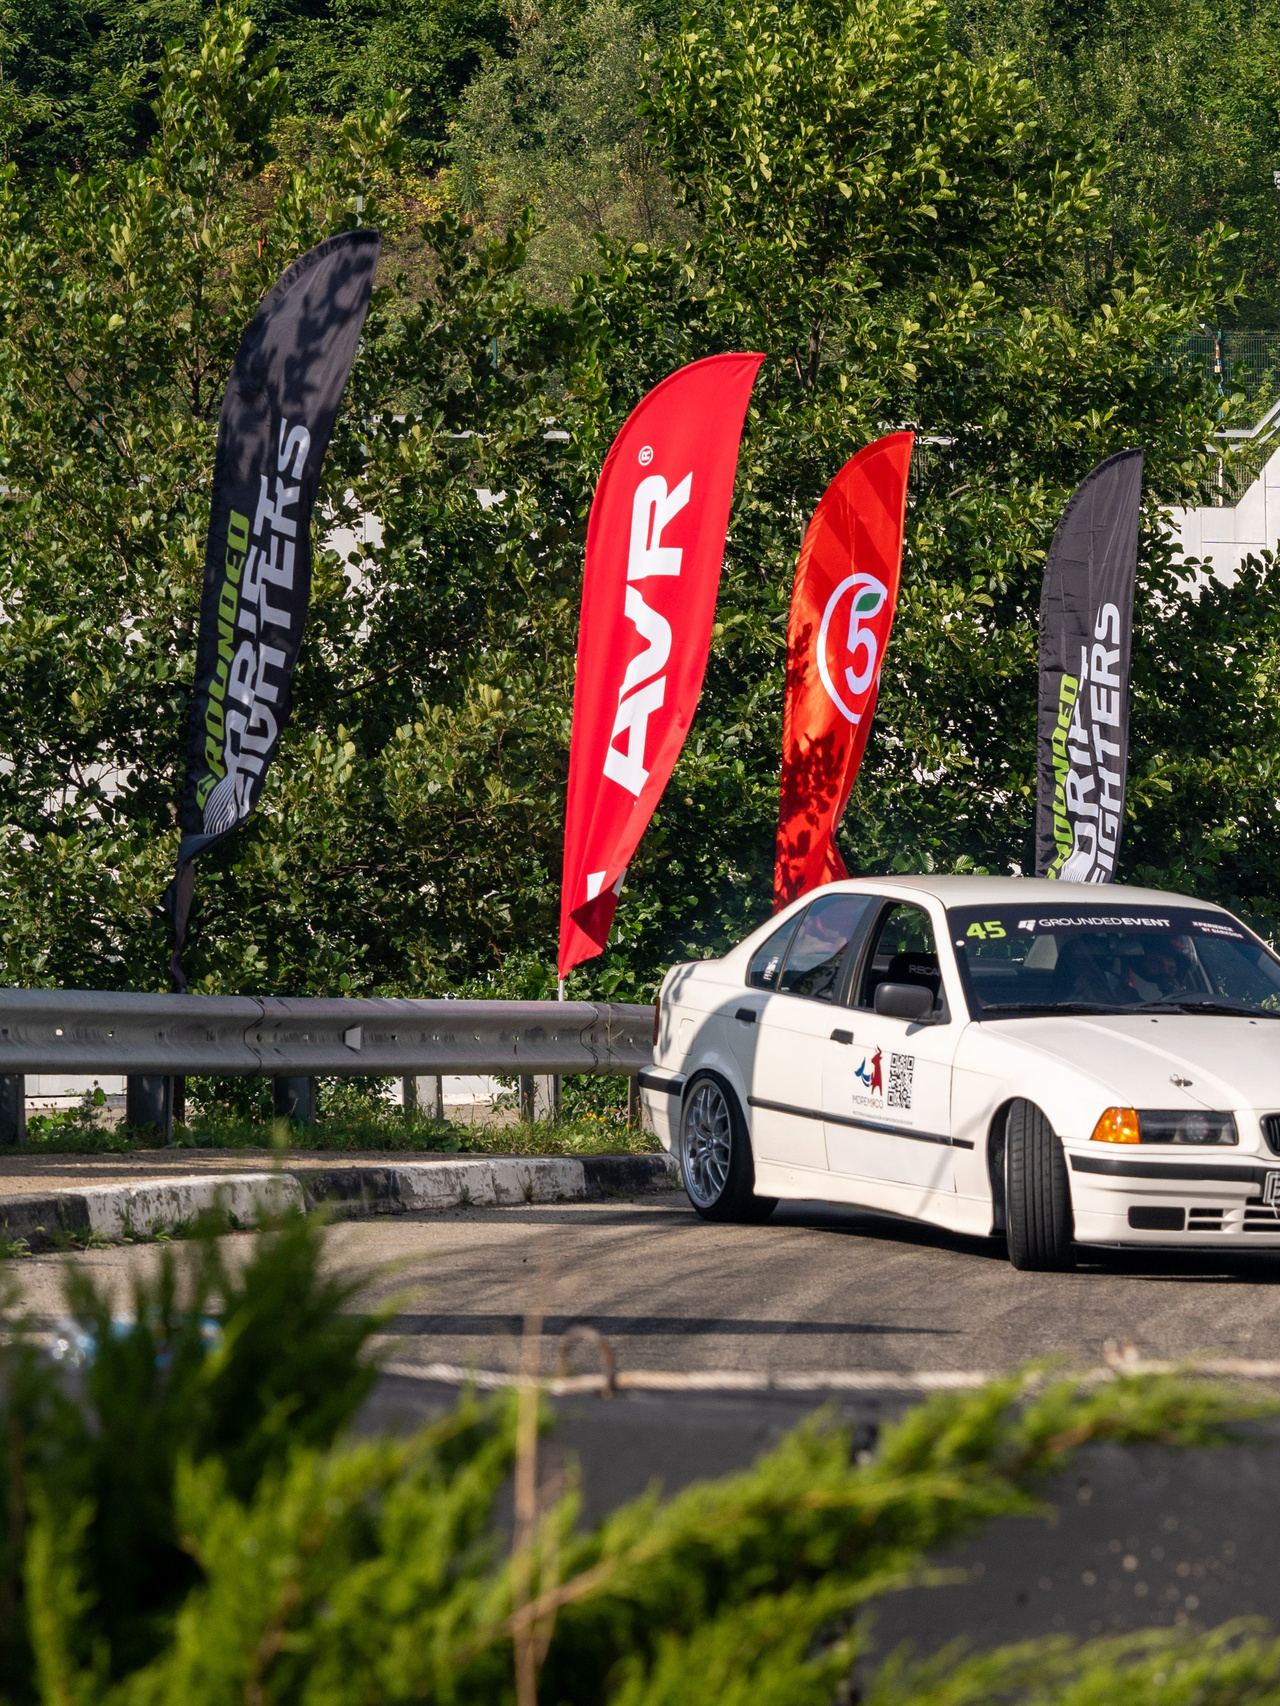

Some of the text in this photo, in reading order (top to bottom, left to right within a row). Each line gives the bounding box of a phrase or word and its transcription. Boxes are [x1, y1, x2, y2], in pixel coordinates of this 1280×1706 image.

[195, 509, 250, 810] GROUNDED
[234, 417, 311, 819] FIGHTERS
[602, 470, 693, 798] AVR
[1047, 673, 1079, 880] ROUNDED
[908, 964, 940, 977] RECA
[966, 920, 1007, 939] 45
